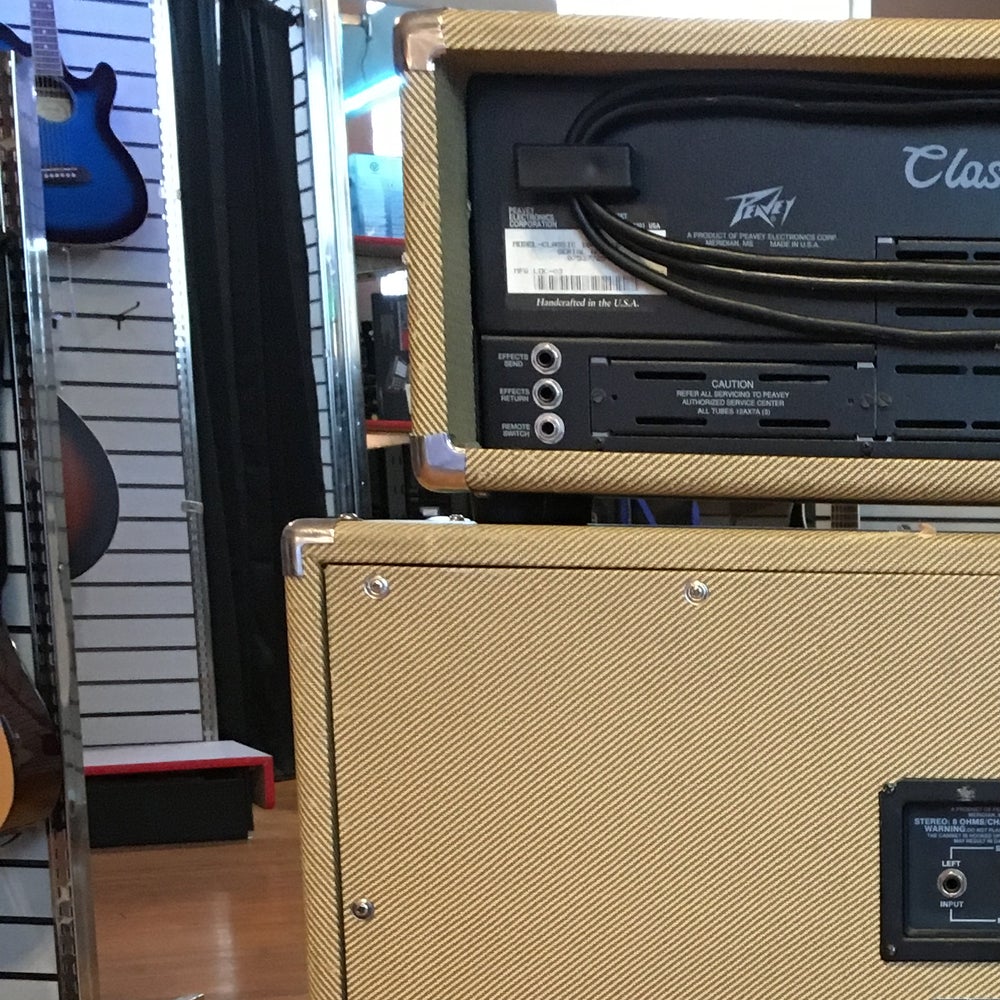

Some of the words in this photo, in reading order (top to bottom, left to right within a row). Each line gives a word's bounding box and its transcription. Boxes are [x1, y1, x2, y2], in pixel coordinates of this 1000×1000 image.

[509, 206, 534, 214] PEAVEY
[510, 220, 557, 228] CORPORATION
[770, 240, 788, 248] MADE
[536, 298, 585, 307] Handcrafted
[588, 298, 596, 307] in
[598, 298, 611, 308] the
[614, 298, 640, 308] U.S.A.
[711, 380, 754, 389] CAUTION
[676, 390, 699, 398] REFER
[714, 390, 750, 398] SERVICING
[942, 860, 961, 868] LEFT
